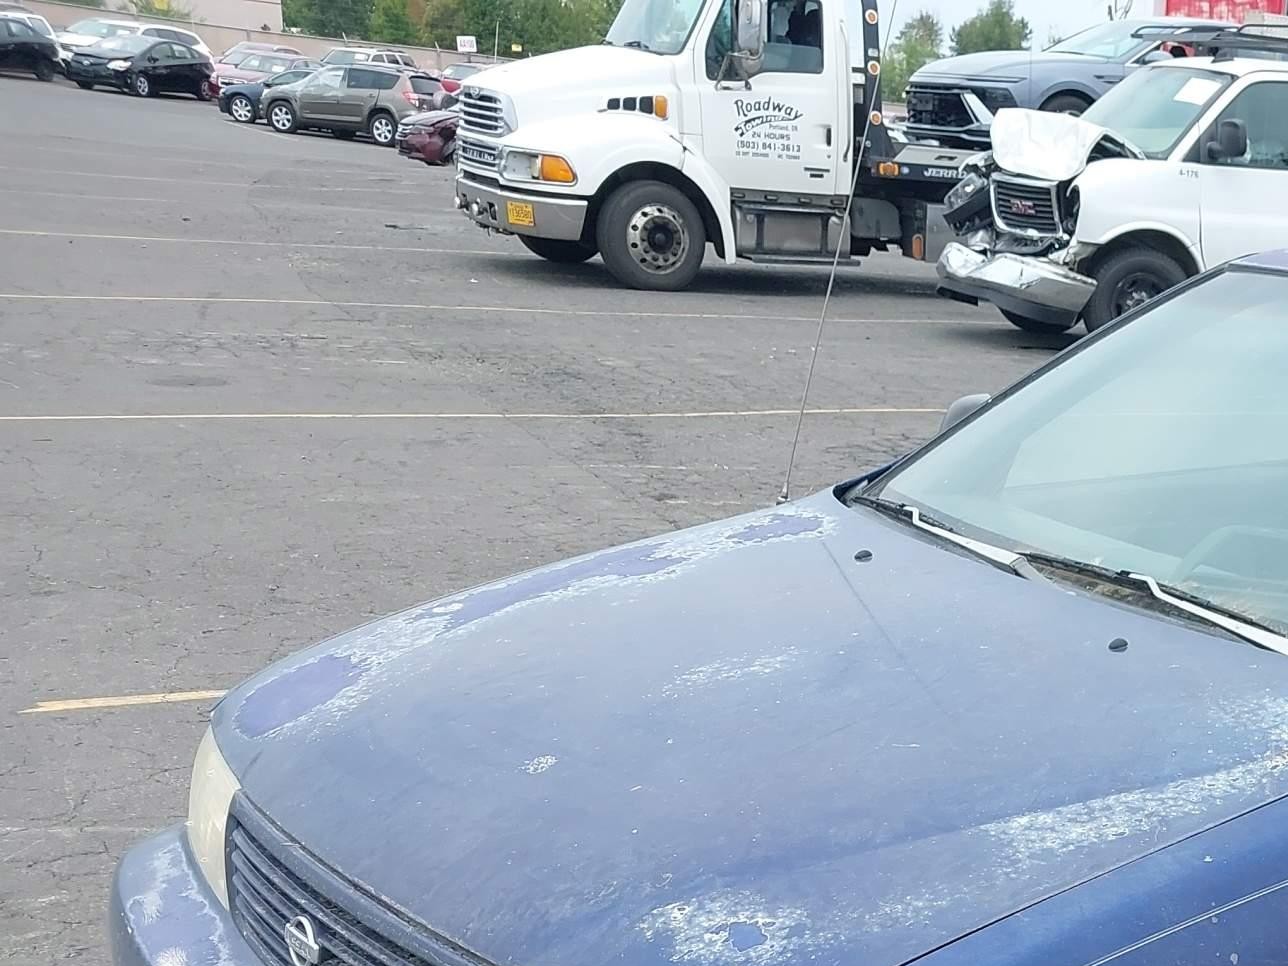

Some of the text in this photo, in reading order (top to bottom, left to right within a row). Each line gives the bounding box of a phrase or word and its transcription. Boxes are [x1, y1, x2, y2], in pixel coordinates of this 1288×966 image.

[734, 96, 804, 121] Roadway
[752, 131, 791, 141] 24 HOURS
[736, 139, 759, 151] (503)
